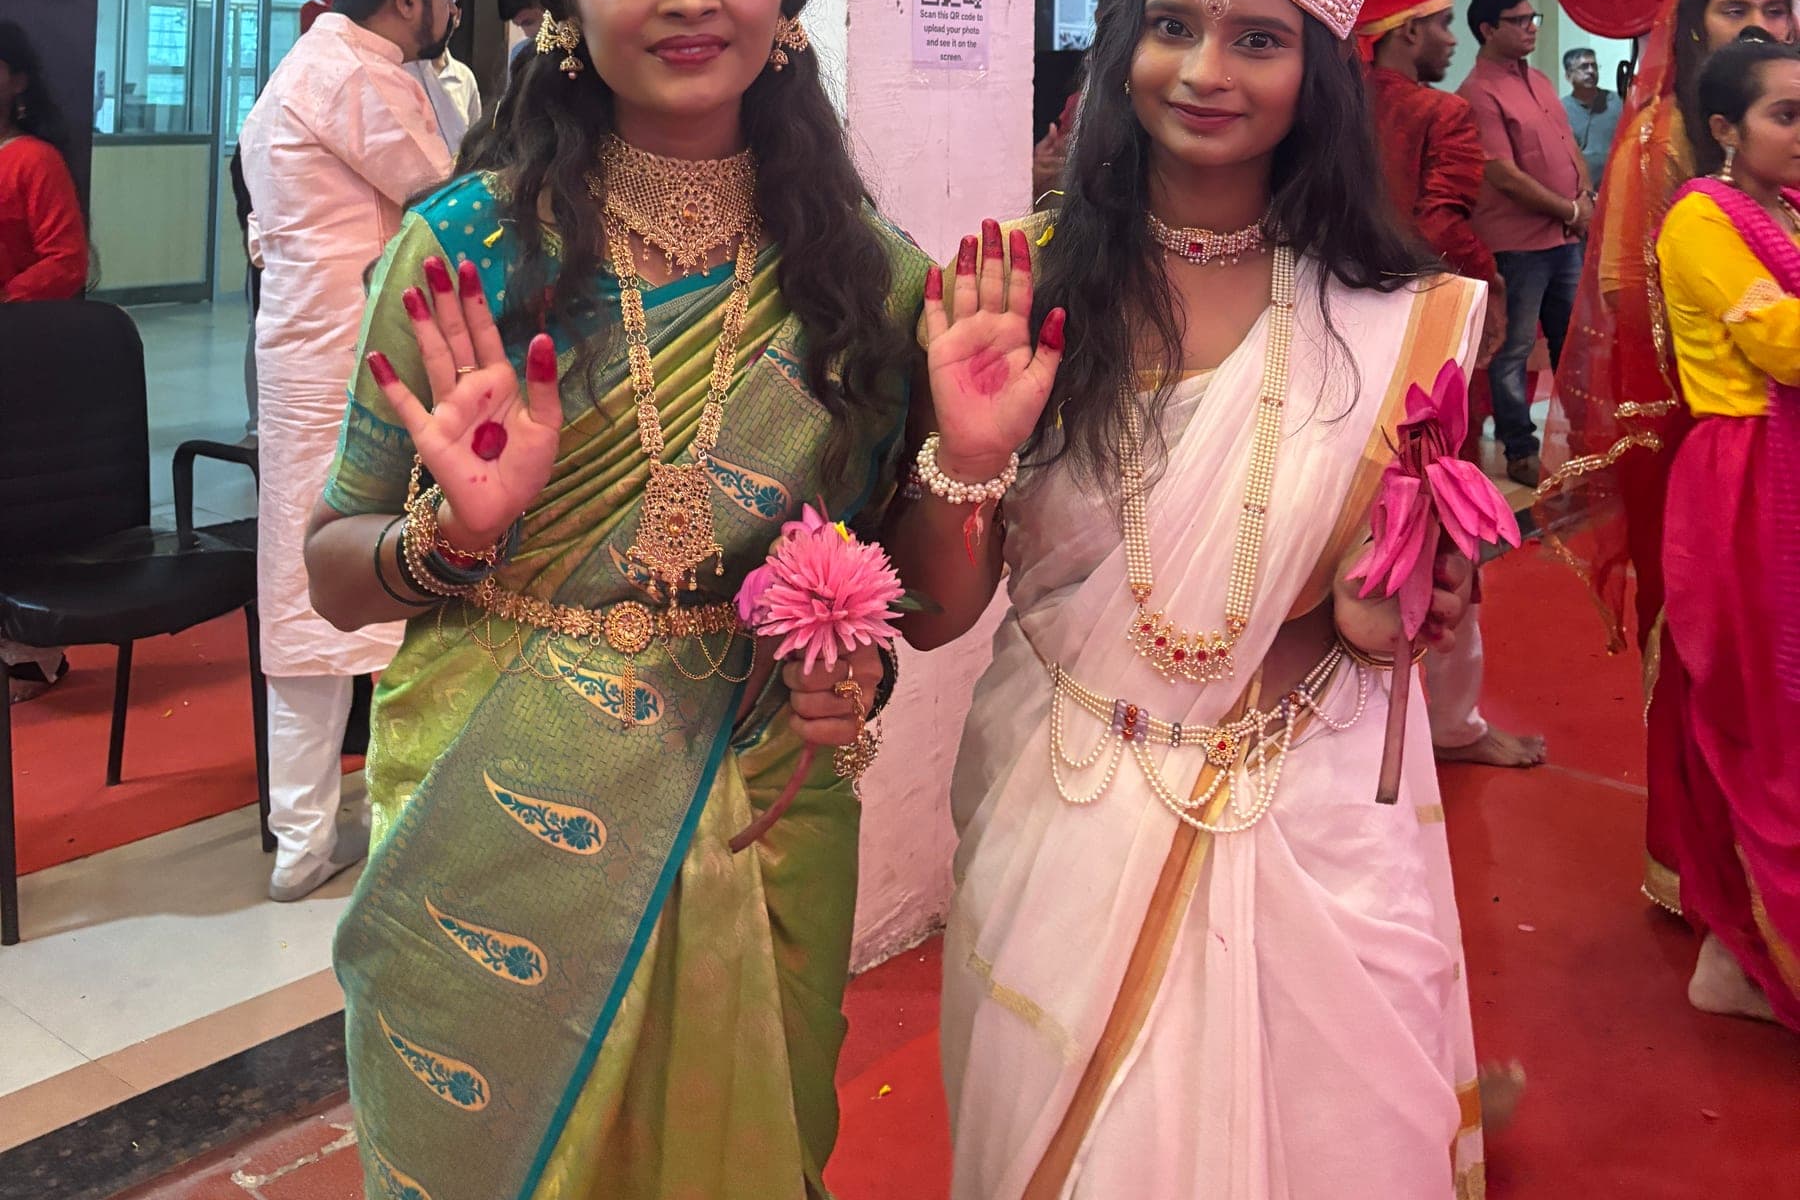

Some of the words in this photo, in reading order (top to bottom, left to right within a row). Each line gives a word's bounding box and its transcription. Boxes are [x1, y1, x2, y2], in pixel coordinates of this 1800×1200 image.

[920, 9, 936, 18] Scan
[938, 11, 948, 19] this
[950, 11, 960, 20] QR
[961, 12, 976, 21] code
[923, 24, 945, 34] upload
[946, 26, 961, 36] your
[962, 26, 980, 36] photo
[952, 39, 957, 48] it
[967, 40, 977, 48] the
